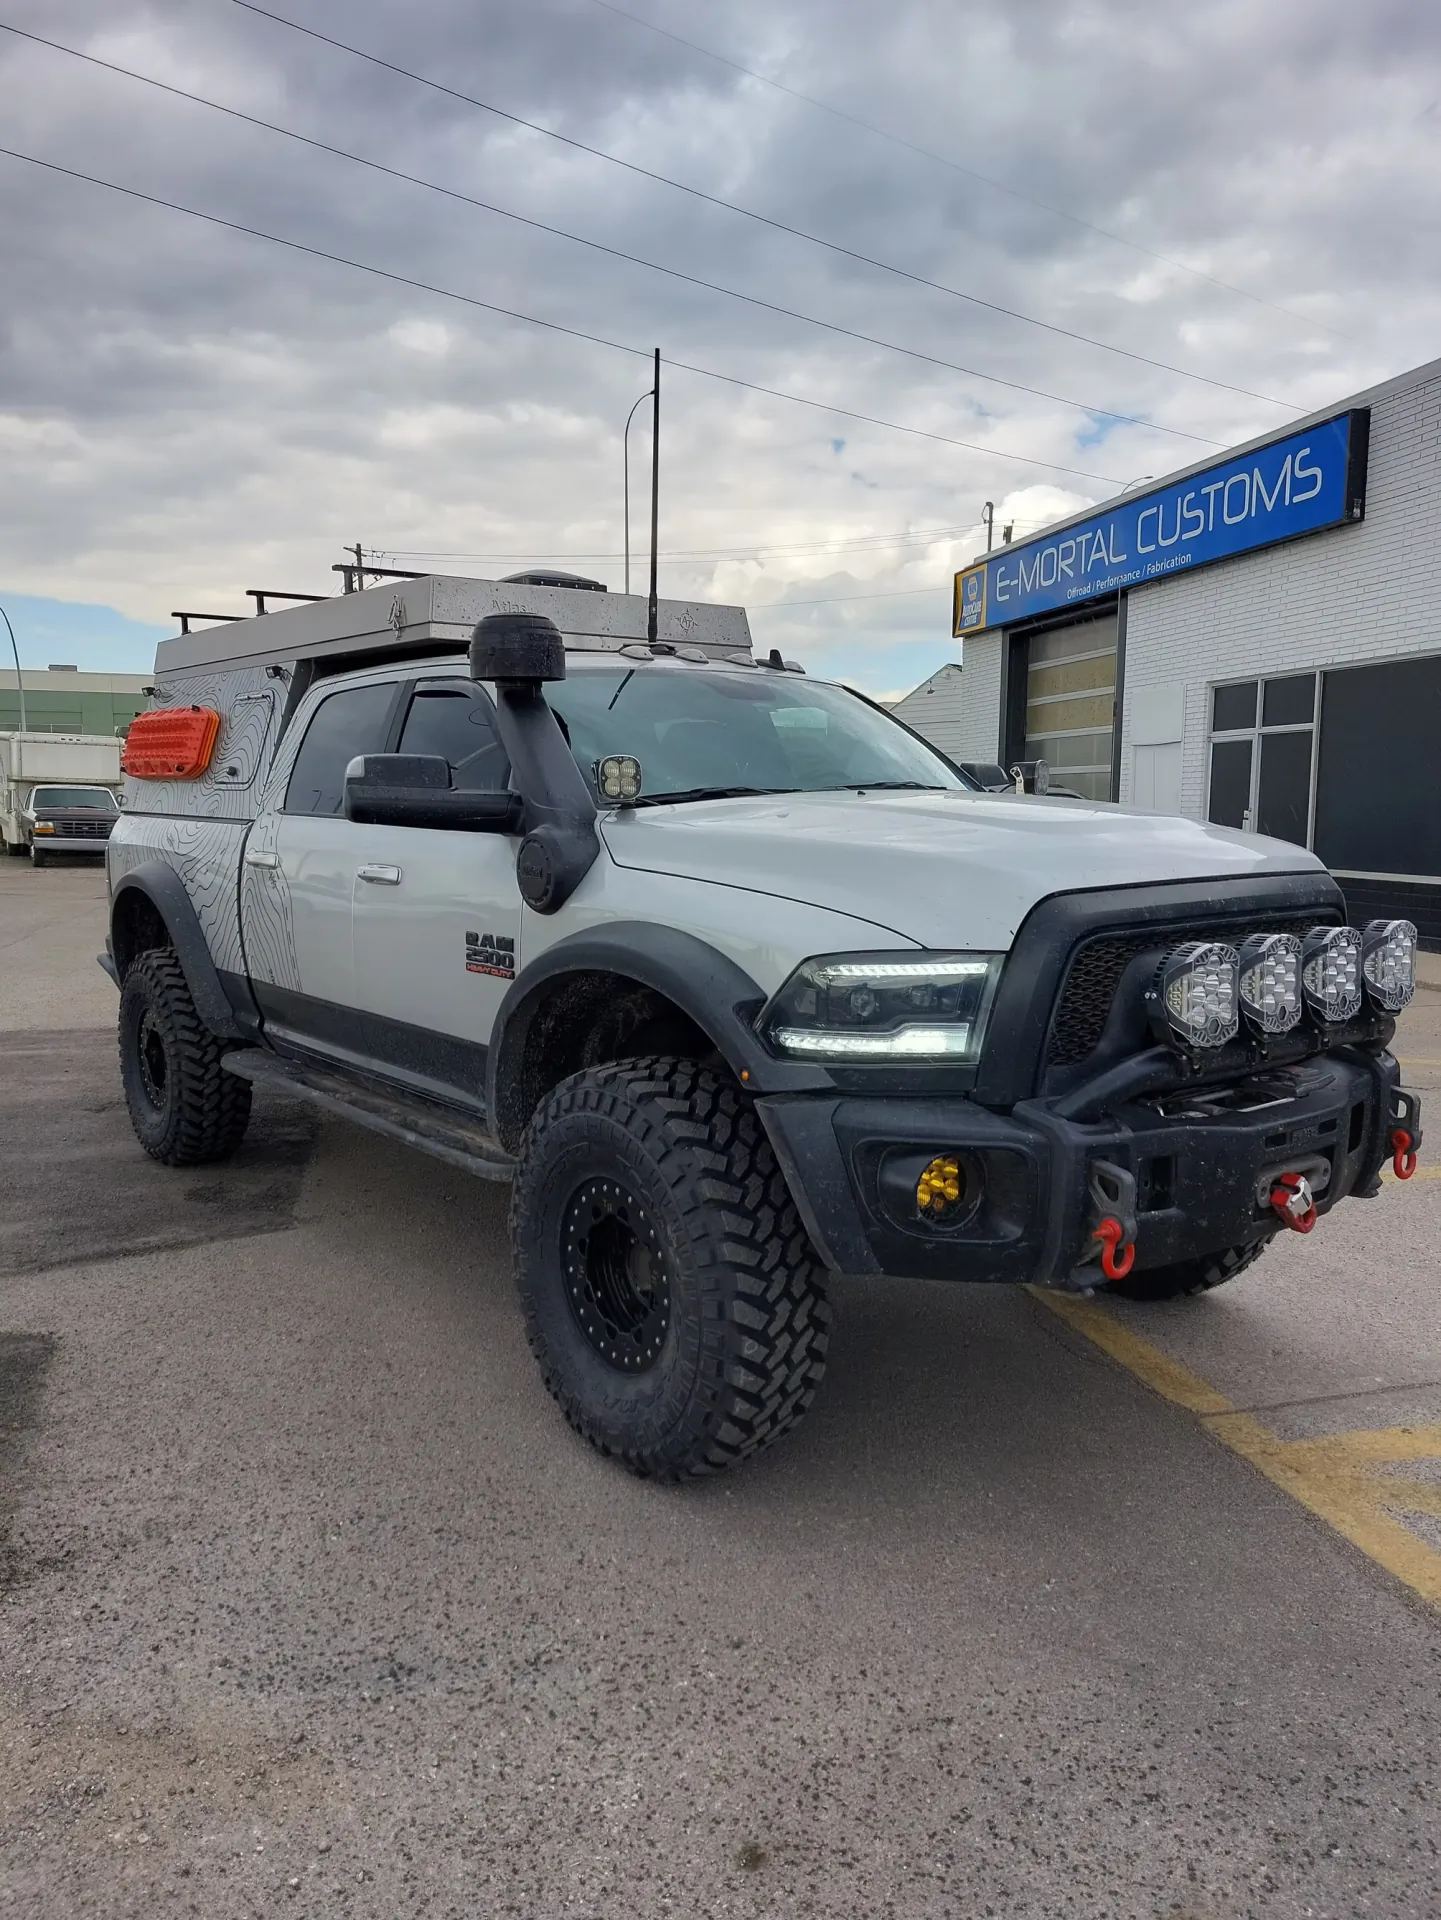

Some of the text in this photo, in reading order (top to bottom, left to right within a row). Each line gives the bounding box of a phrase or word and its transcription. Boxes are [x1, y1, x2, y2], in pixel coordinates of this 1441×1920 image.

[996, 447, 1322, 602] E-MORTAL CUSTOMS
[1066, 583, 1091, 599] Offroad
[1146, 553, 1192, 575] Fabrication
[466, 930, 514, 953] RAM
[466, 946, 514, 970] 2500
[466, 963, 512, 979] HEAVY DUTY
